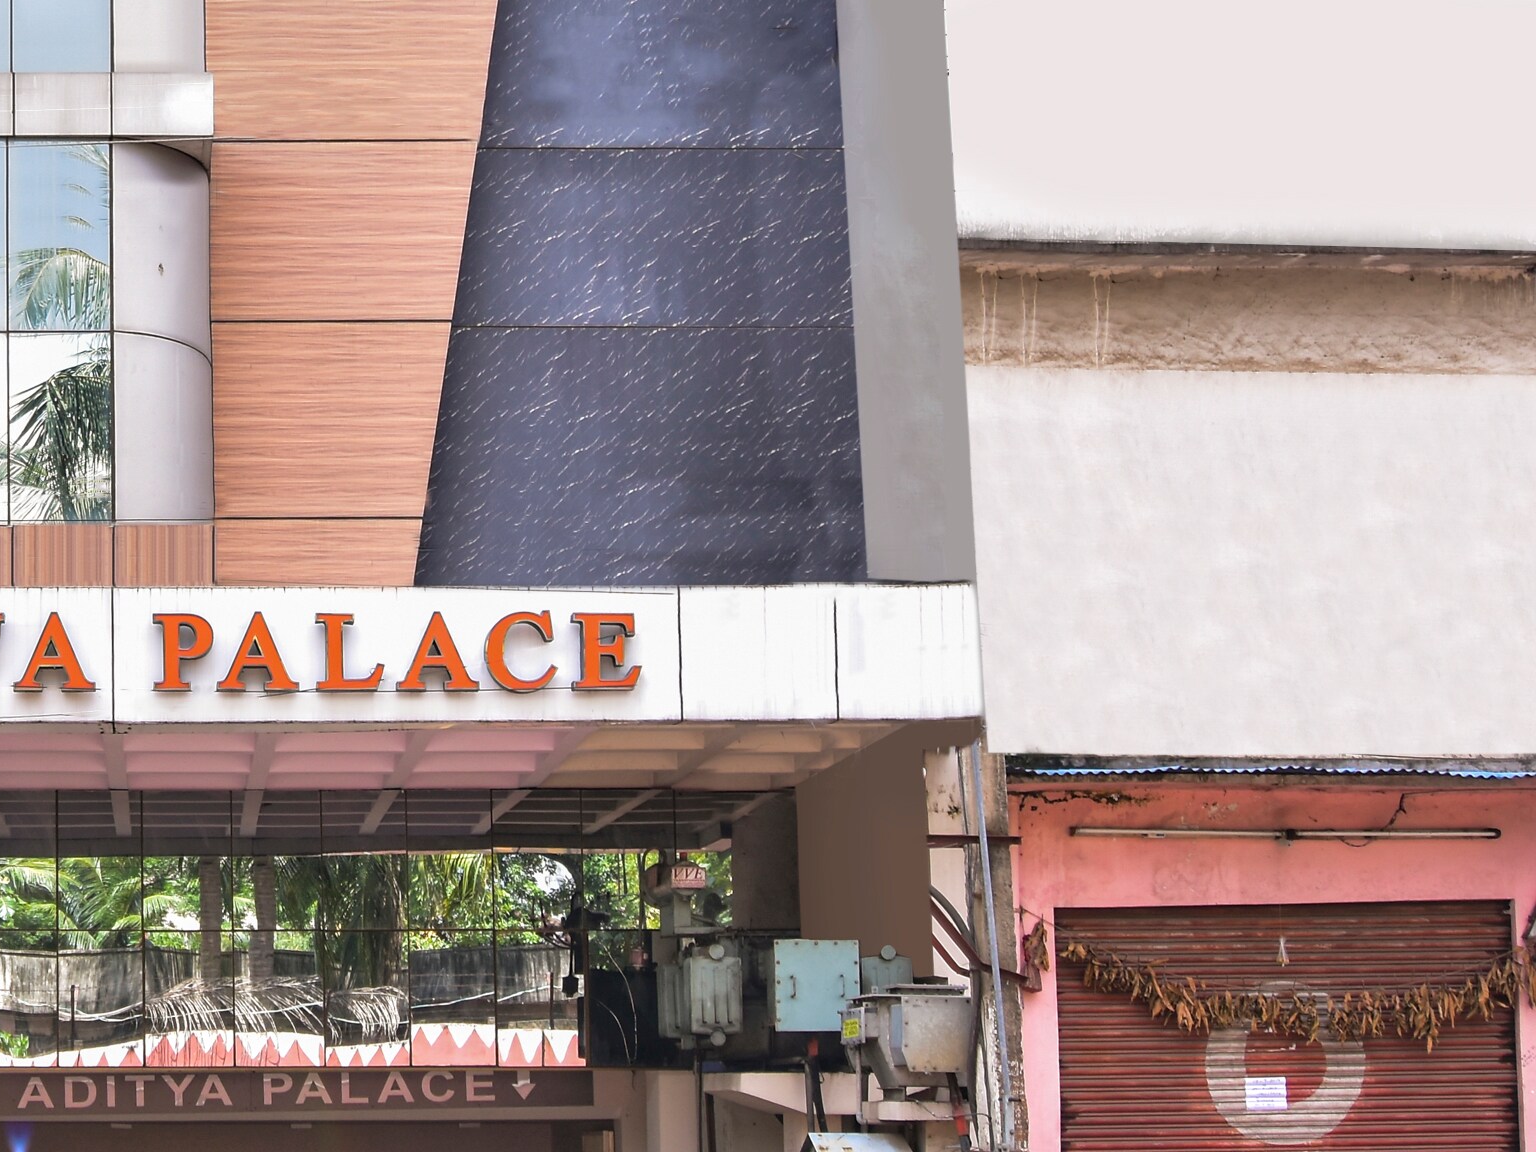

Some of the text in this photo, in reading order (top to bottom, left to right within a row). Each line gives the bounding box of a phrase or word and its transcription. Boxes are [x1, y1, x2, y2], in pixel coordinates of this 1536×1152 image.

[151, 610, 643, 693] PALACE
[16, 1069, 496, 1109] ADITYA PALACE
